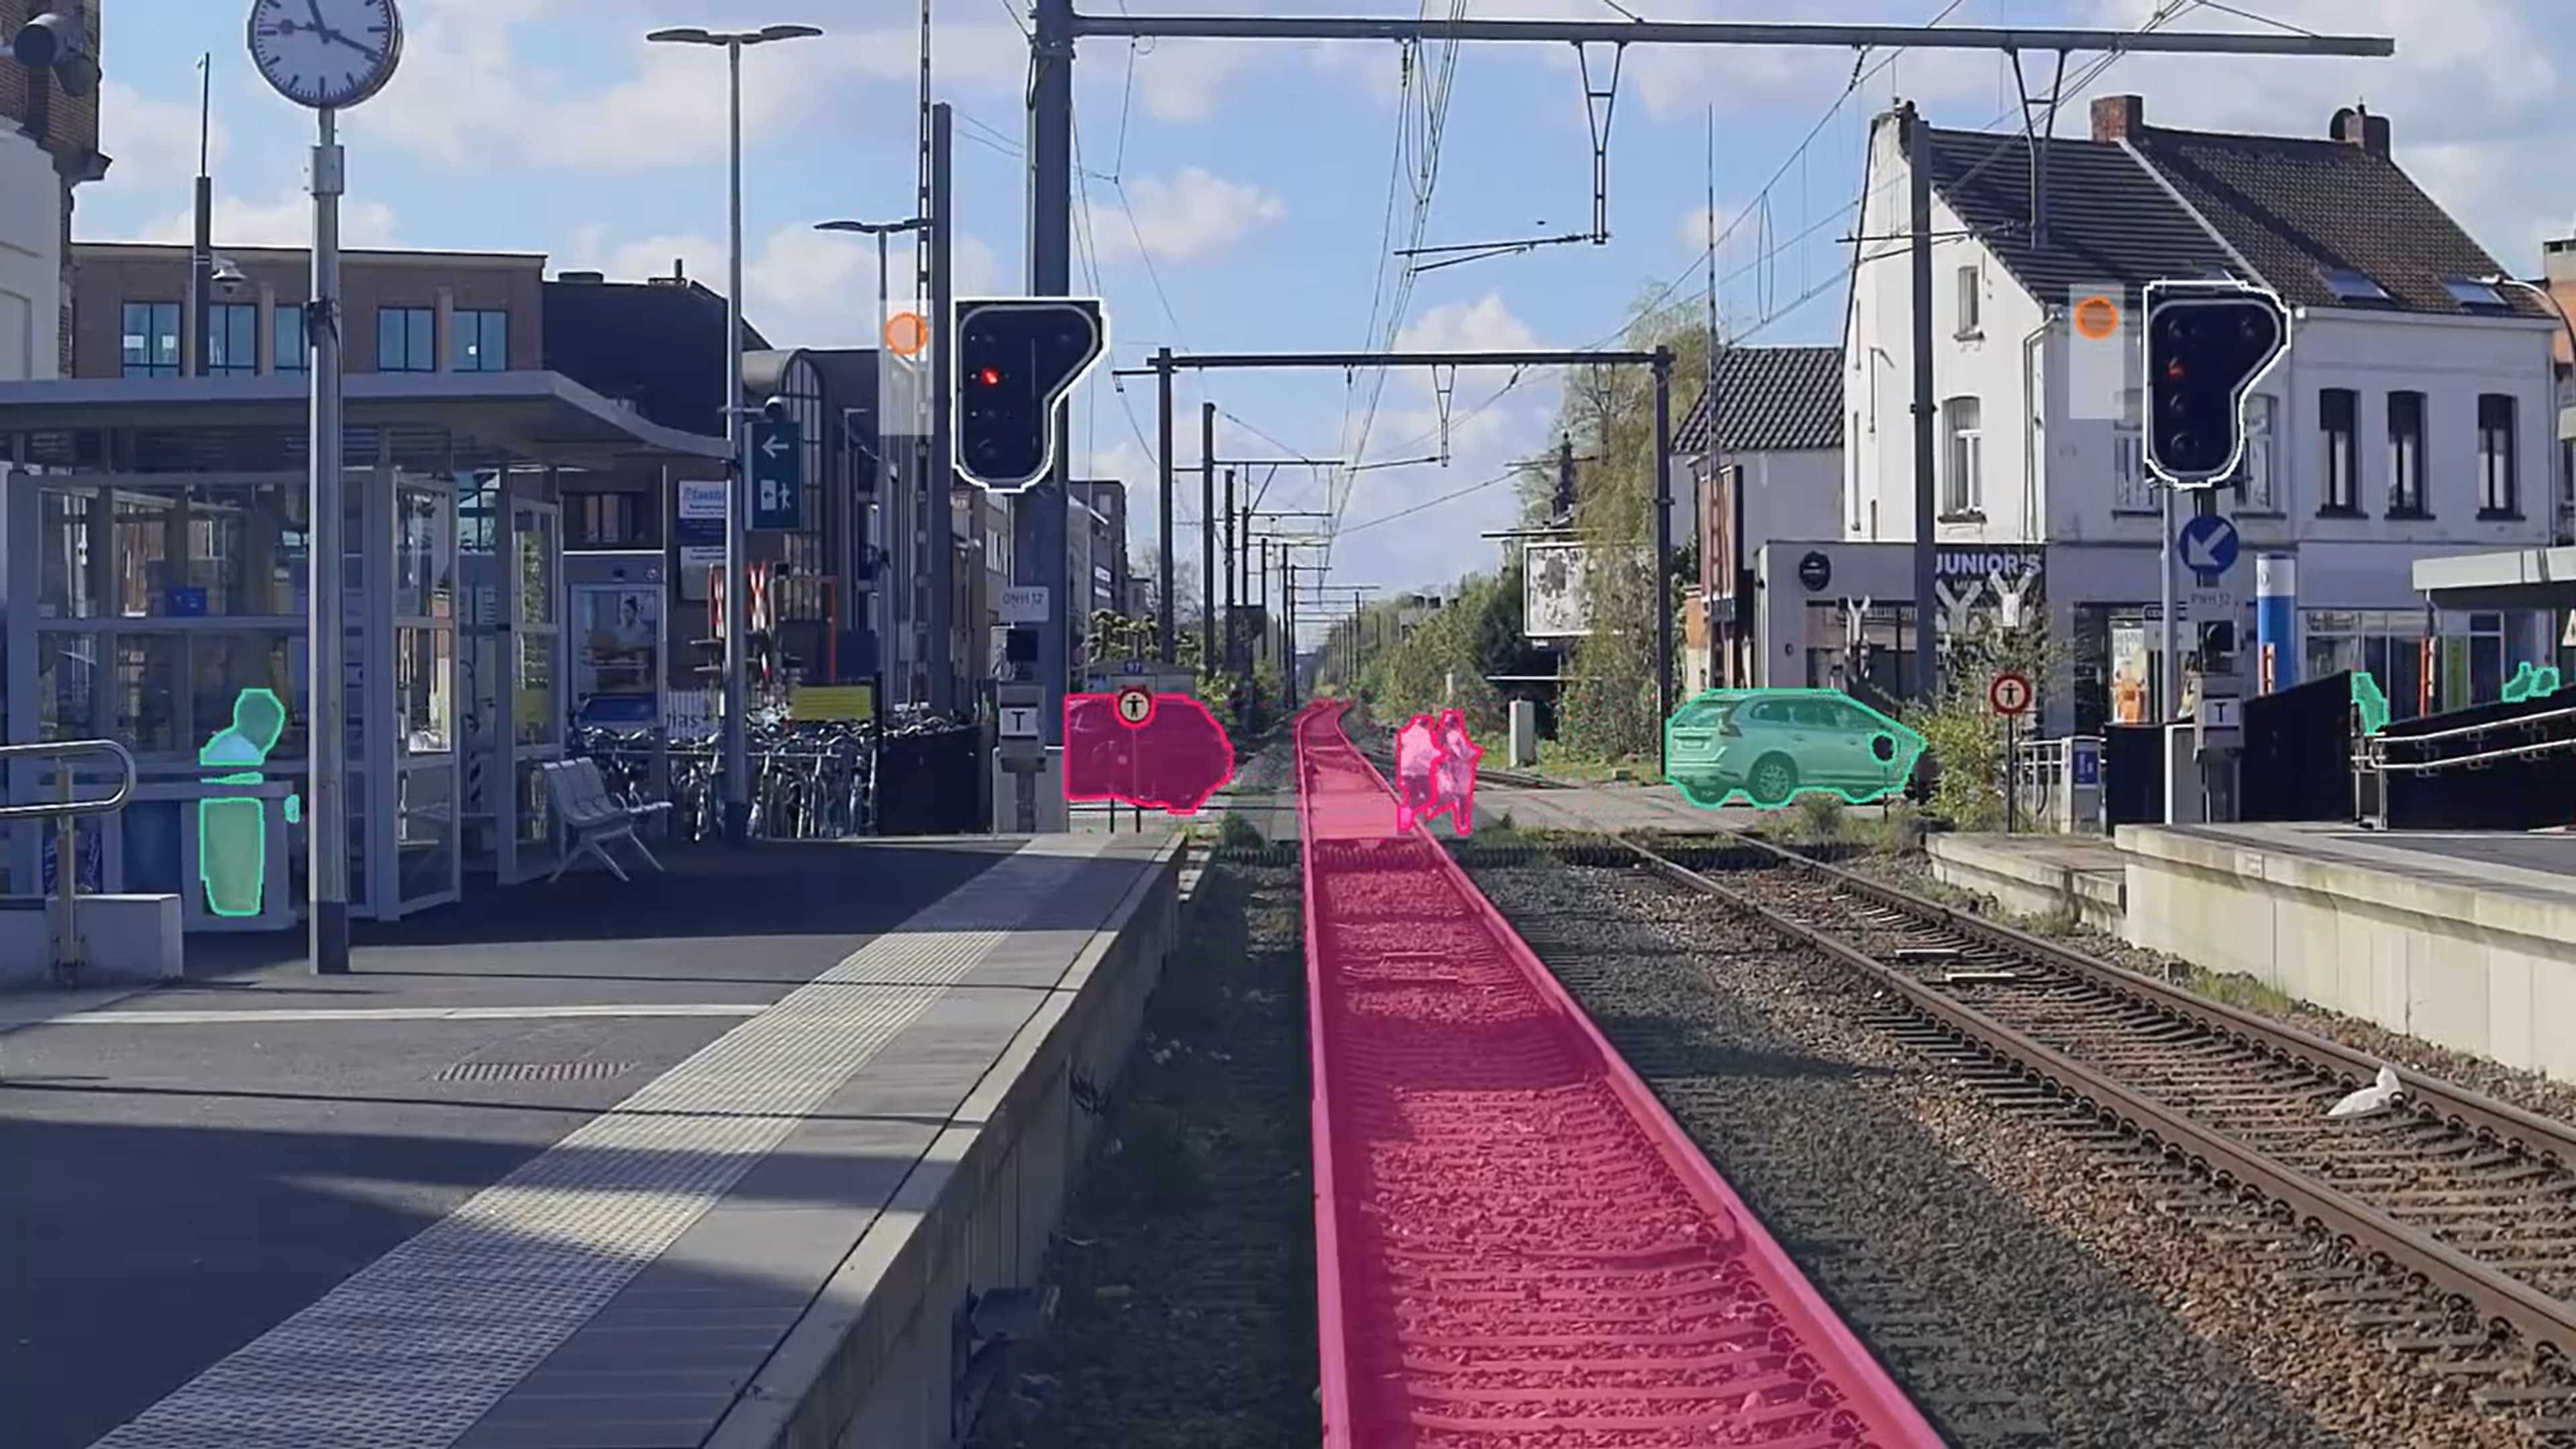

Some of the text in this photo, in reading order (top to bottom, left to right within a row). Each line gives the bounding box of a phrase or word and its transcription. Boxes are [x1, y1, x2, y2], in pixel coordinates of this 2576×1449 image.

[1935, 553, 2043, 575] JUNIOR'S
[1011, 711, 1026, 732] T
[2214, 702, 2227, 723] T
